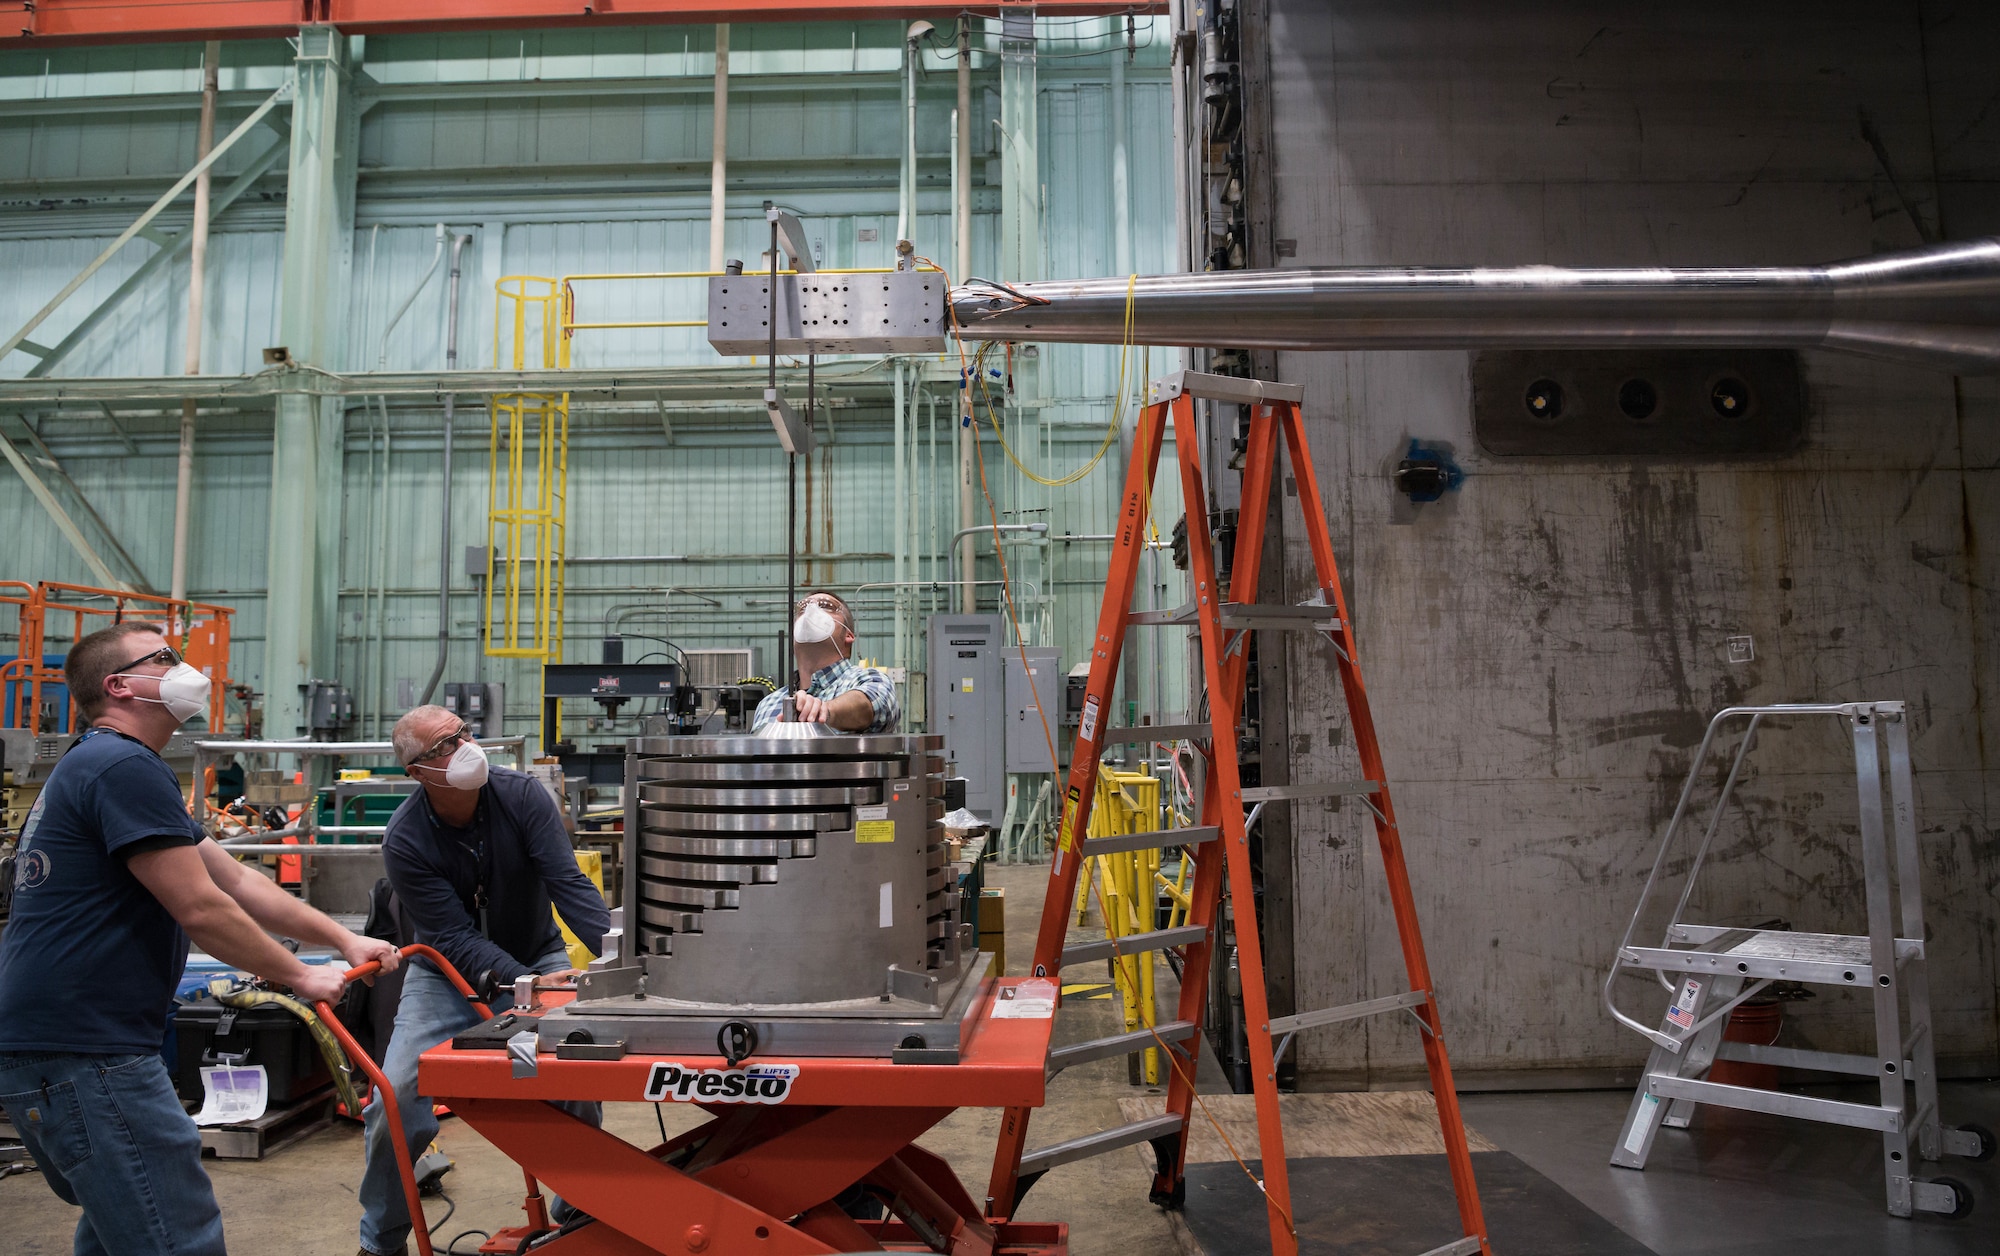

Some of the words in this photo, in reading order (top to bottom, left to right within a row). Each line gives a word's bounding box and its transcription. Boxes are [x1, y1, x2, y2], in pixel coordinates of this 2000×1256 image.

[801, 276, 809, 287] 15
[841, 276, 849, 286] 16
[649, 1066, 787, 1098] Presto
